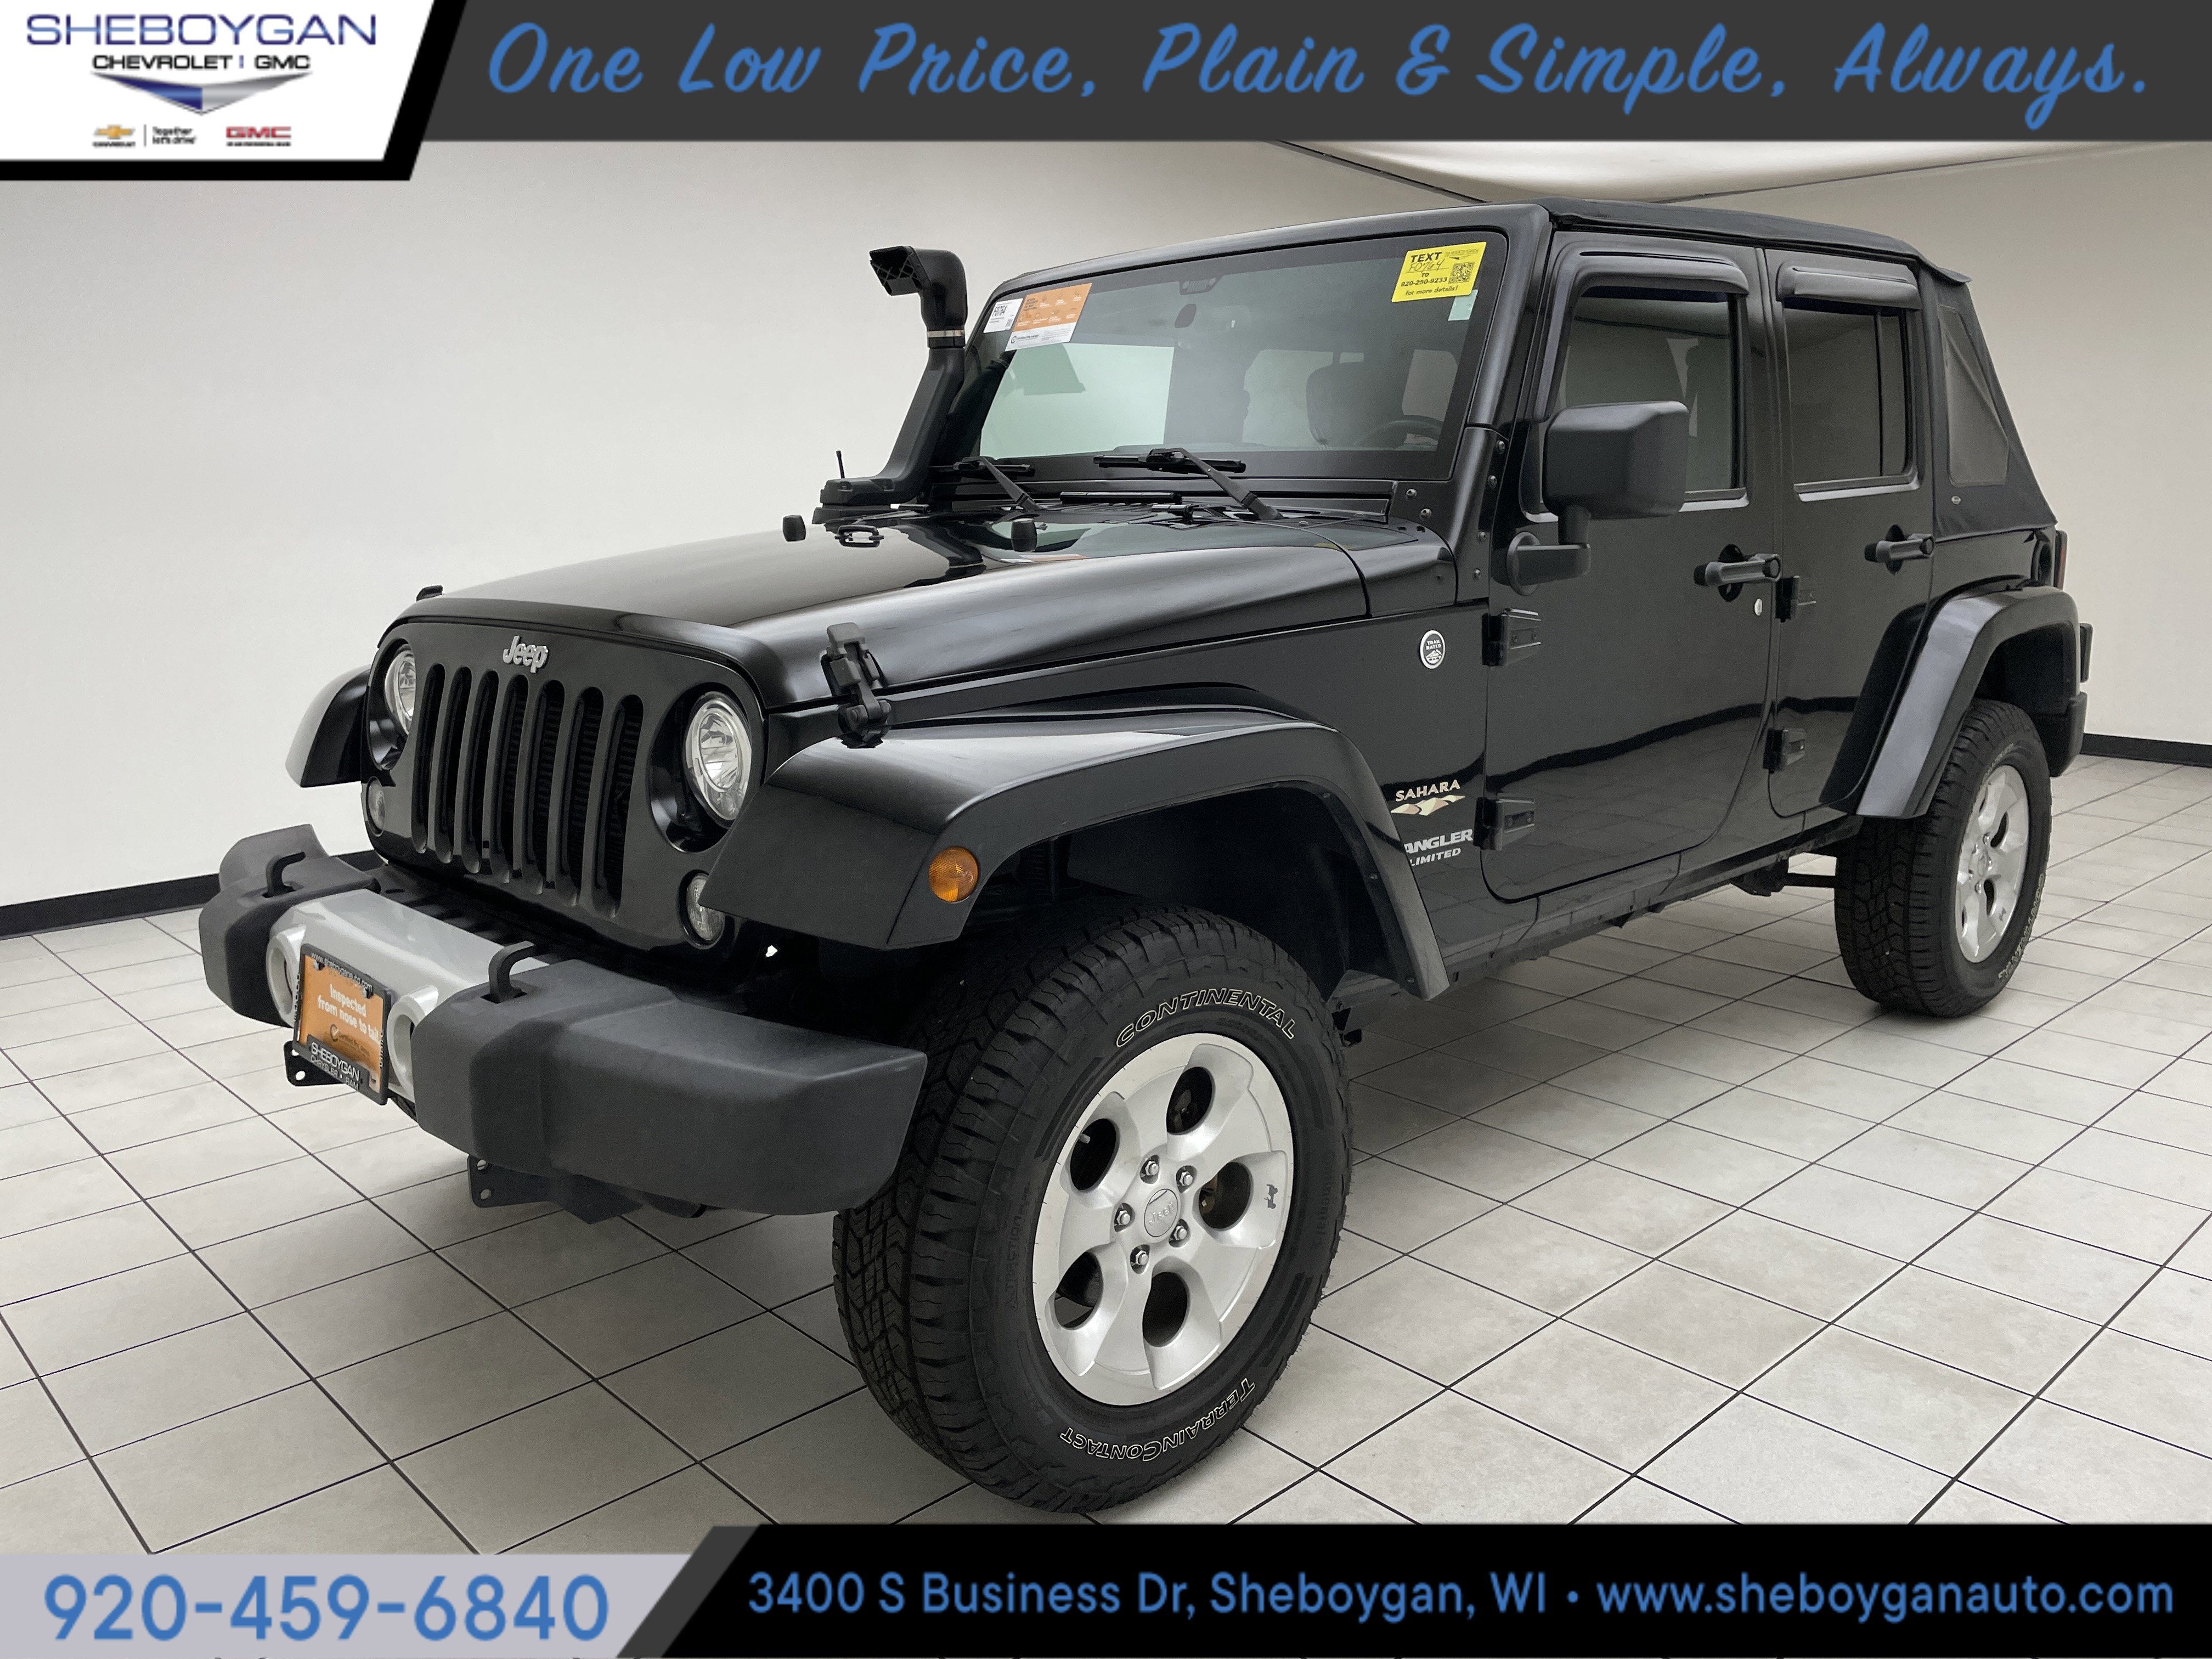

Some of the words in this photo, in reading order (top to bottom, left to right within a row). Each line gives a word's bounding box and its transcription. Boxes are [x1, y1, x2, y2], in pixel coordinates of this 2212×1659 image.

[1410, 252, 1443, 263] TEXT
[1401, 277, 1448, 287] 920-250-9233
[503, 635, 549, 673] Jeep
[1395, 780, 1460, 802] SAHARA
[1404, 828, 1474, 854] ANGLER
[1409, 848, 1462, 866] LIMITED
[318, 995, 338, 1017] from
[339, 1009, 358, 1029] nose
[330, 983, 367, 1018] Inspected
[1116, 988, 1296, 1047] CONTINENTAL
[312, 1042, 360, 1081] SHEBOYGAN
